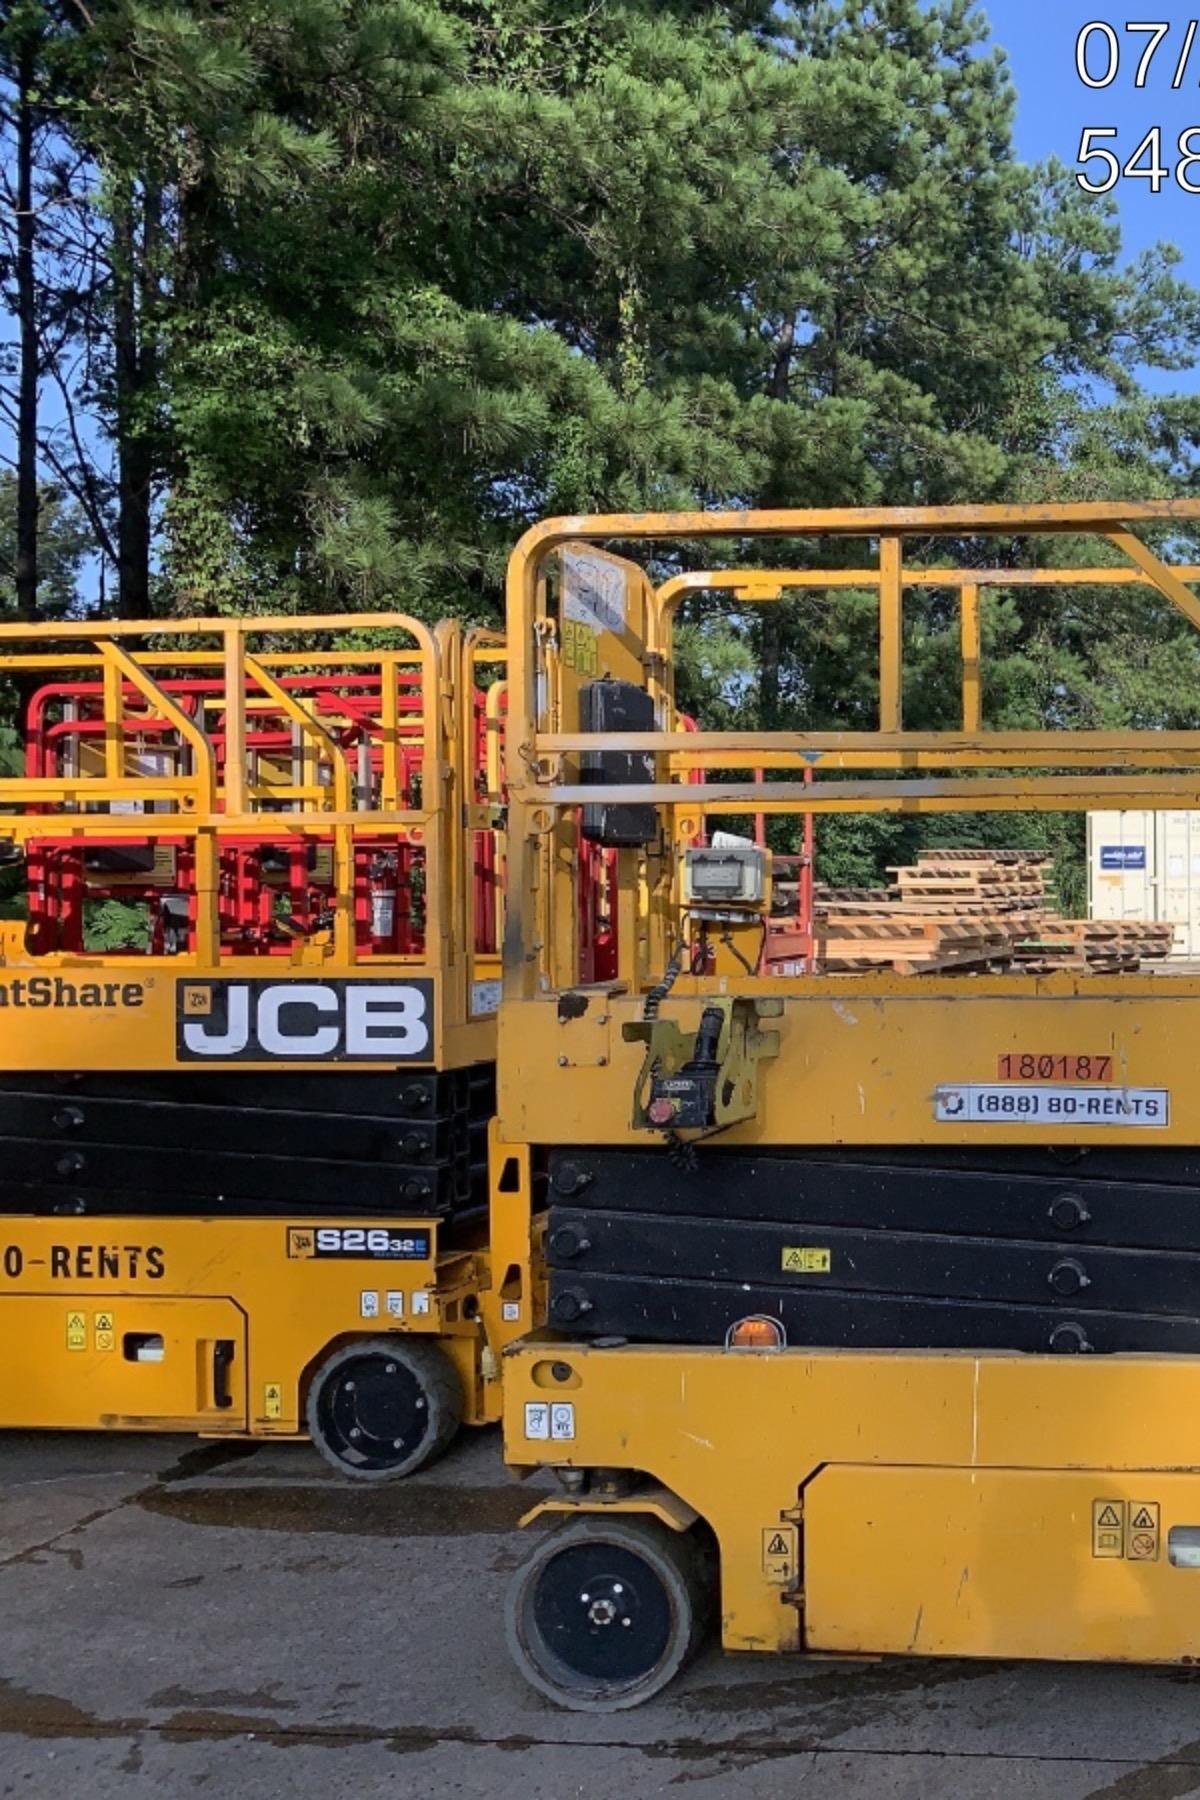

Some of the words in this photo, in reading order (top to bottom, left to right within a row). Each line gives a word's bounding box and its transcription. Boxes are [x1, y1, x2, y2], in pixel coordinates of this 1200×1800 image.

[183, 985, 429, 1055] JCB
[1000, 1054, 1112, 1080] 180187
[977, 1093, 1039, 1115] (888)
[1047, 1097, 1159, 1117] 80-RENTS
